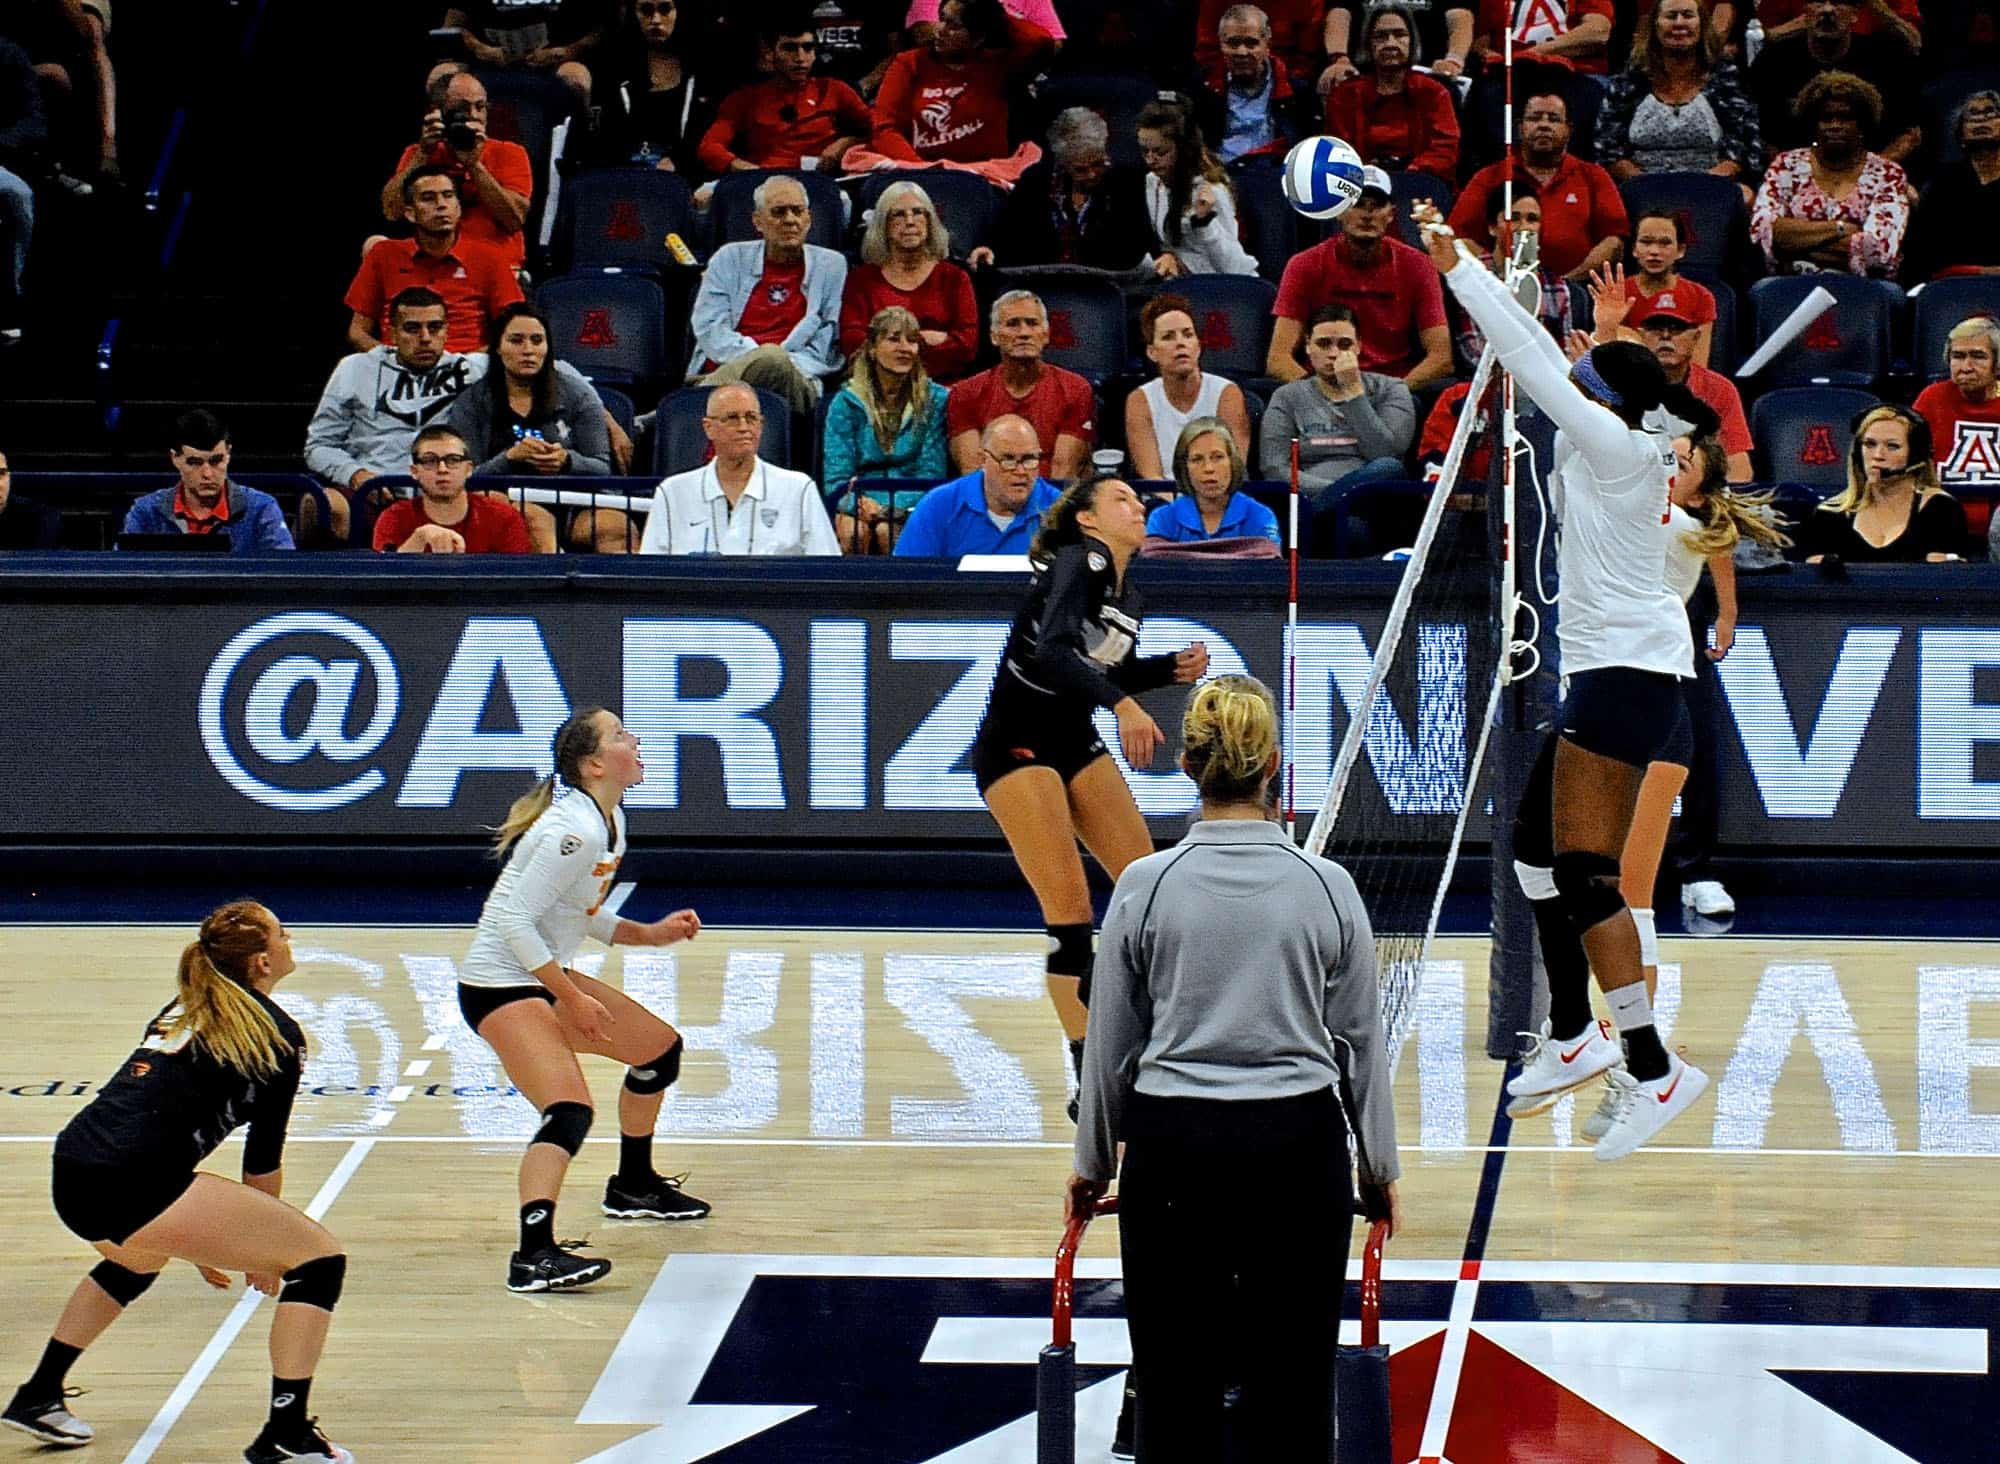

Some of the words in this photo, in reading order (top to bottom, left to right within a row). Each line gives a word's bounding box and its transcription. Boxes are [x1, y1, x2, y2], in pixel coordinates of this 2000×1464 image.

[391, 357, 471, 401] NIKE
[1799, 423, 1841, 465] A
[1937, 420, 2000, 484] A
[198, 611, 2000, 819] @ARIZONV
